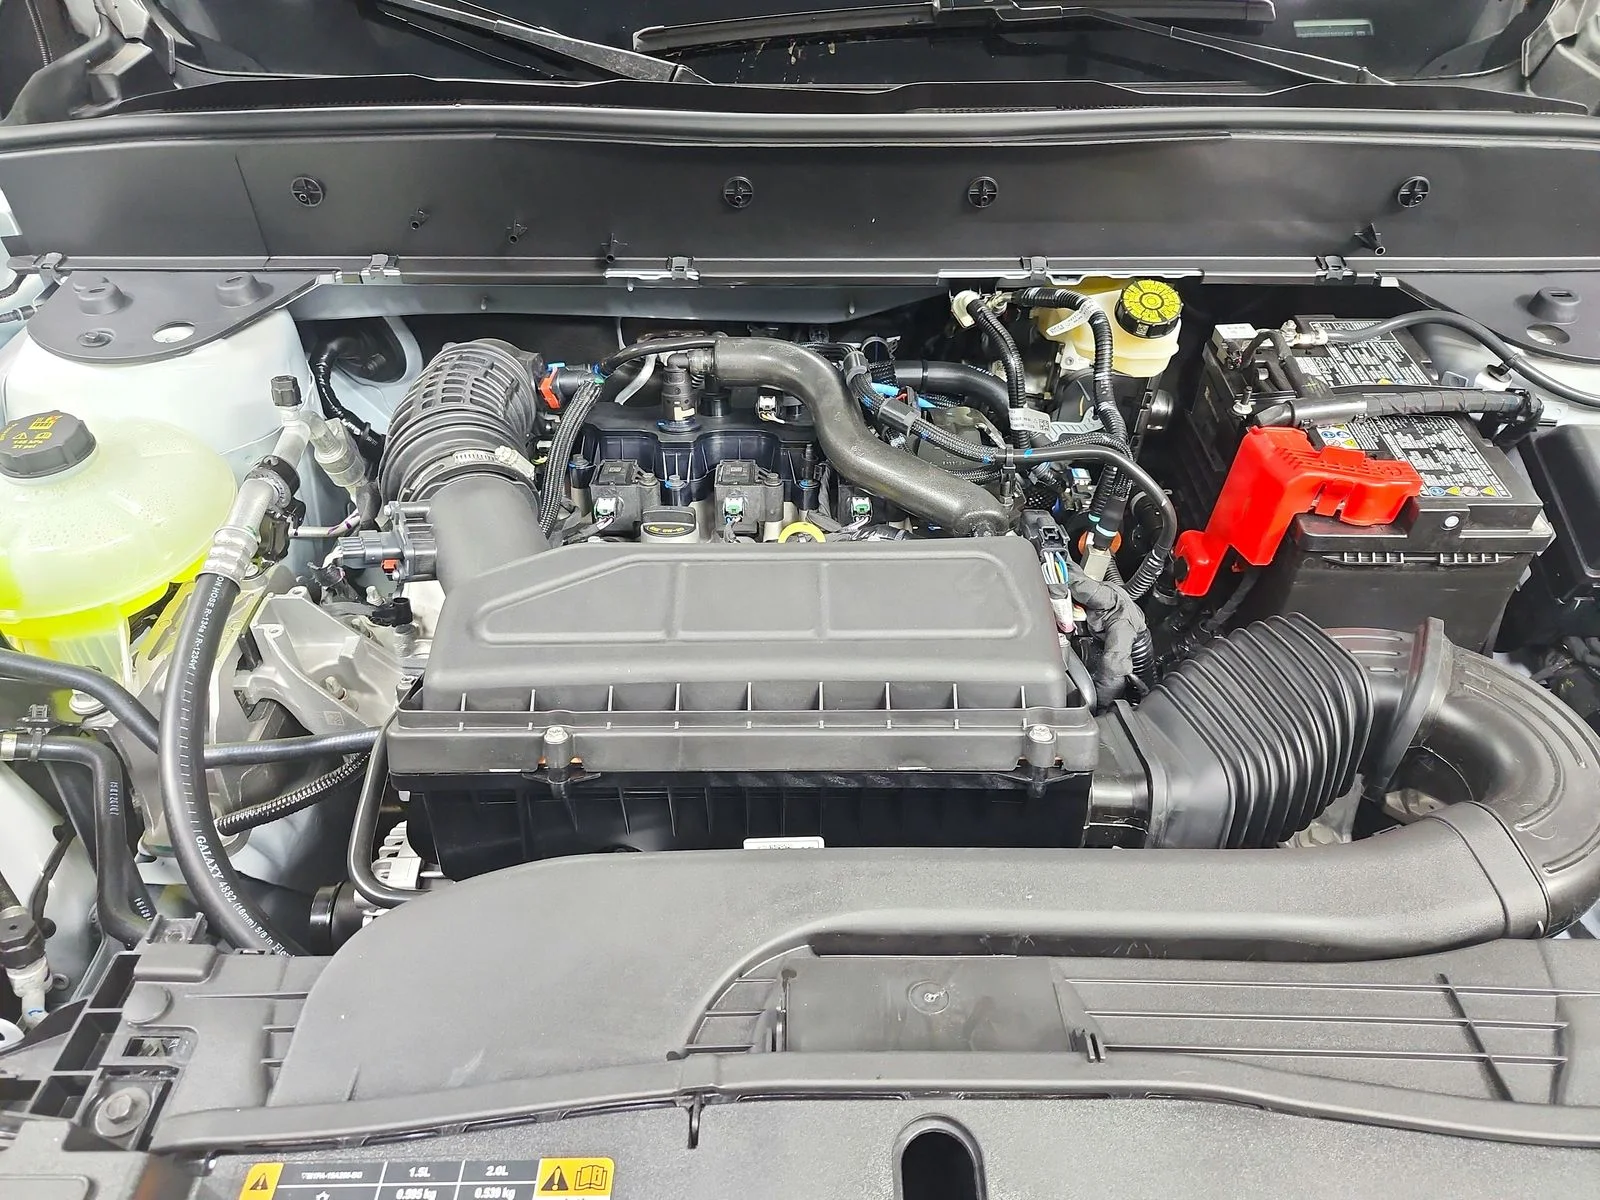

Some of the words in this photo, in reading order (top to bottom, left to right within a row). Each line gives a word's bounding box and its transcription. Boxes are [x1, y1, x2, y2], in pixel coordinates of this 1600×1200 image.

[206, 587, 220, 608] HOSE
[196, 835, 224, 879] GALAXY
[219, 881, 237, 903] 4882
[233, 902, 258, 929] (16mm)
[408, 1166, 431, 1177] 1.5L
[485, 1165, 509, 1177] 2.0L
